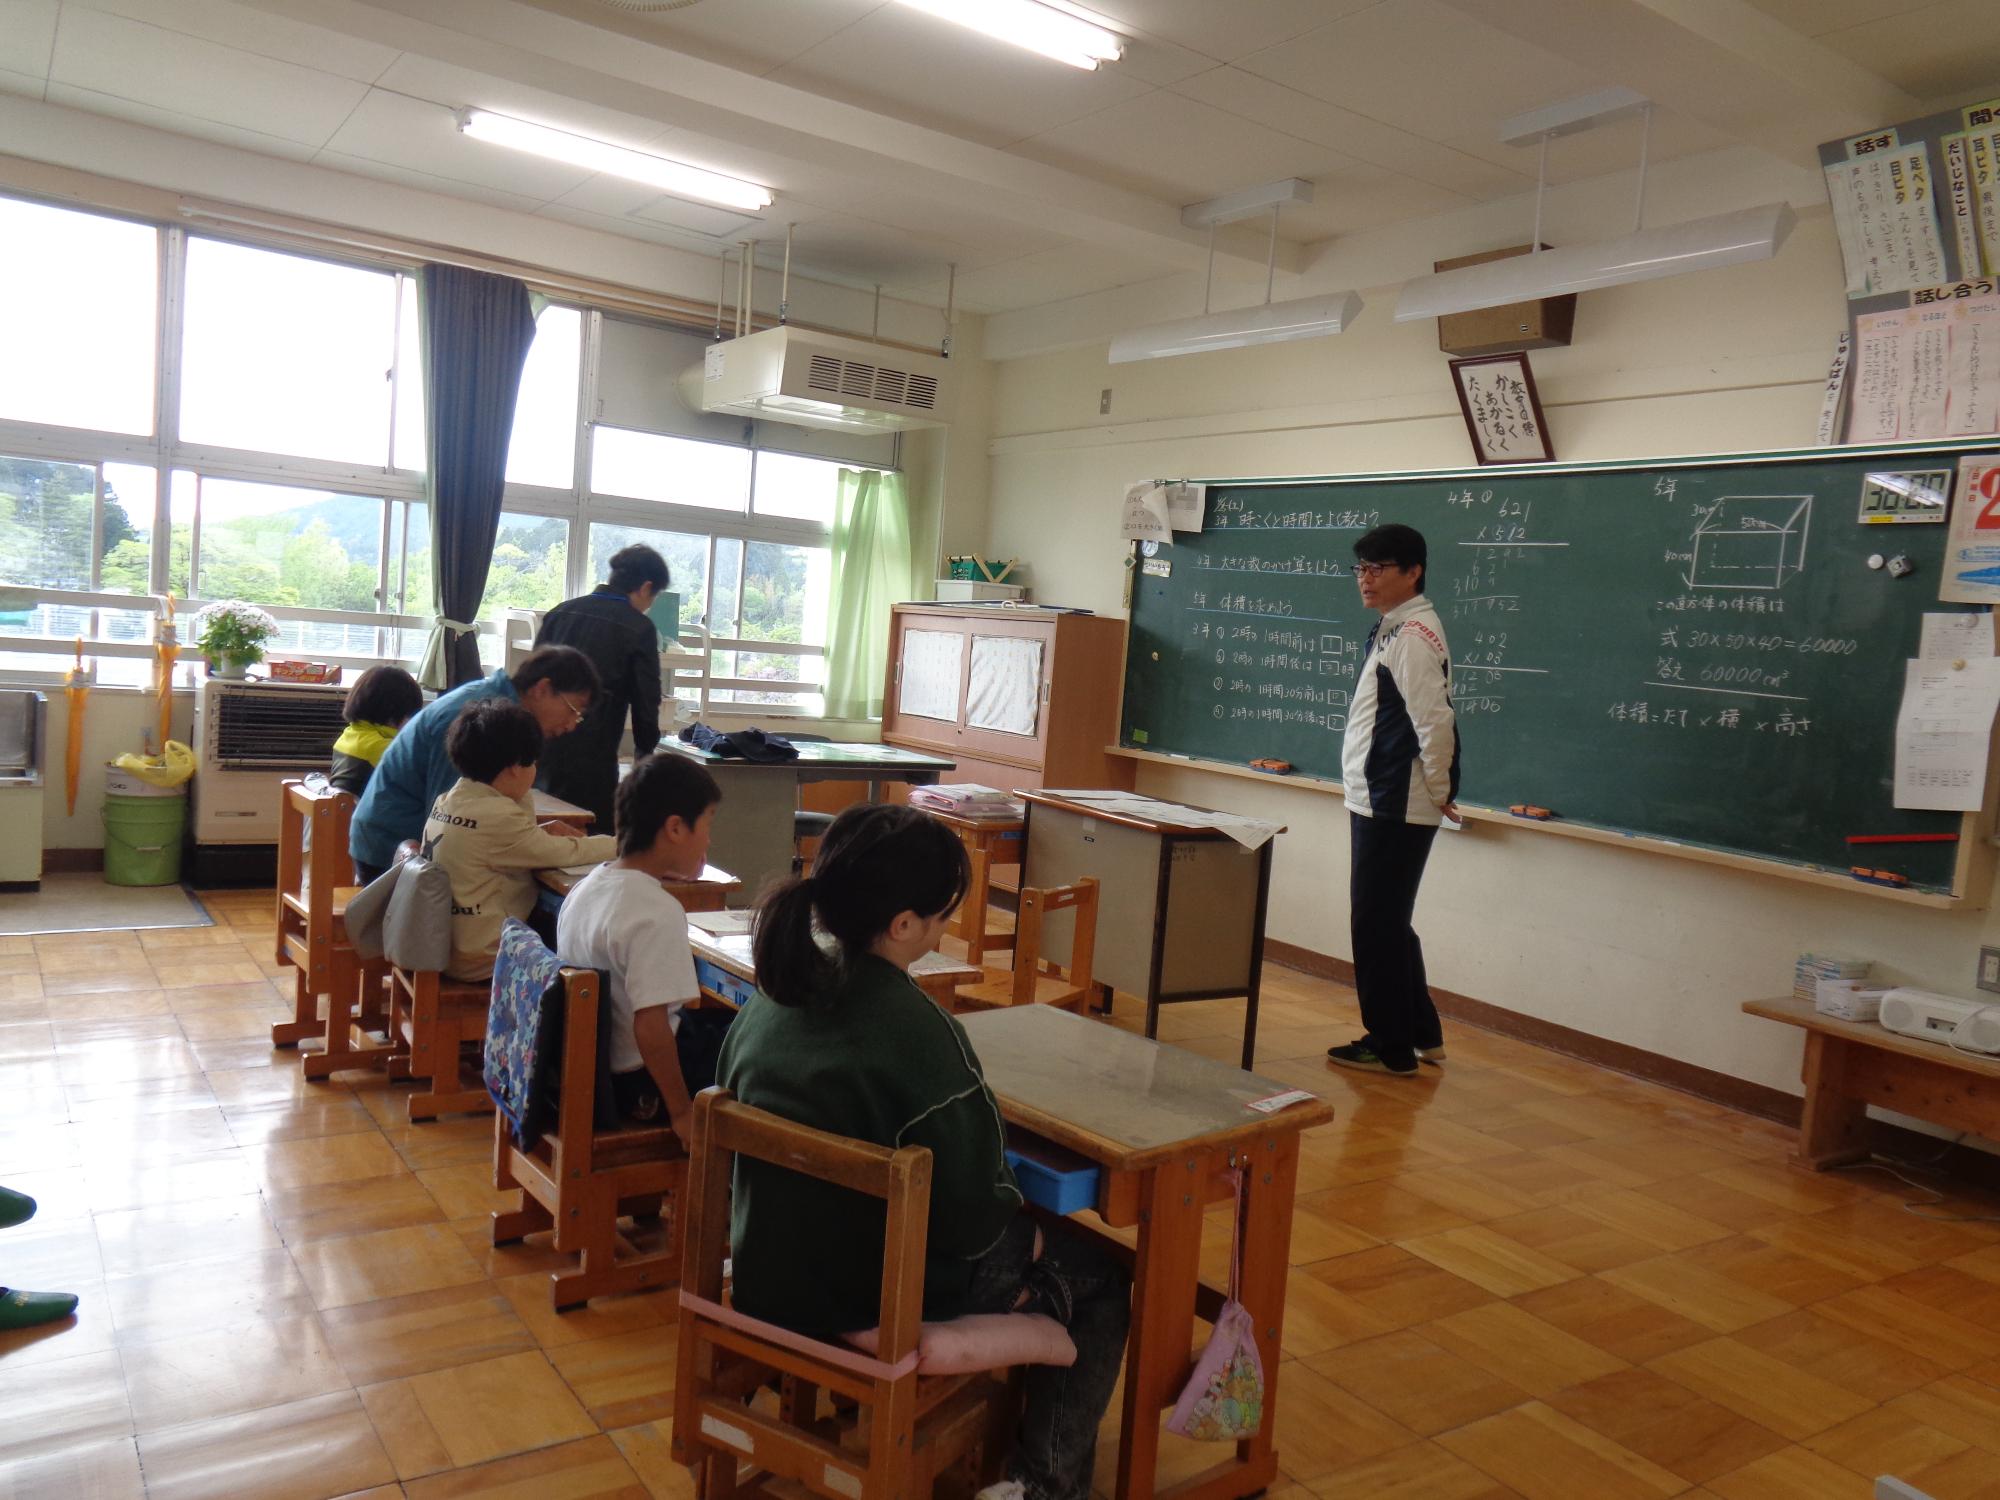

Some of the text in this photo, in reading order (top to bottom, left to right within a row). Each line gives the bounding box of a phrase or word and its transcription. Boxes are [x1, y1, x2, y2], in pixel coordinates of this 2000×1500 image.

[1854, 134, 1892, 155] 話す
[1948, 141, 1968, 217] だいじなこと
[1914, 281, 1993, 305] 話し合う
[1469, 375, 1497, 453] たくましく
[1495, 373, 1518, 439] かしこく
[1448, 489, 1474, 509] 4年
[1654, 476, 1679, 501] 5年
[1498, 497, 1532, 523] 621
